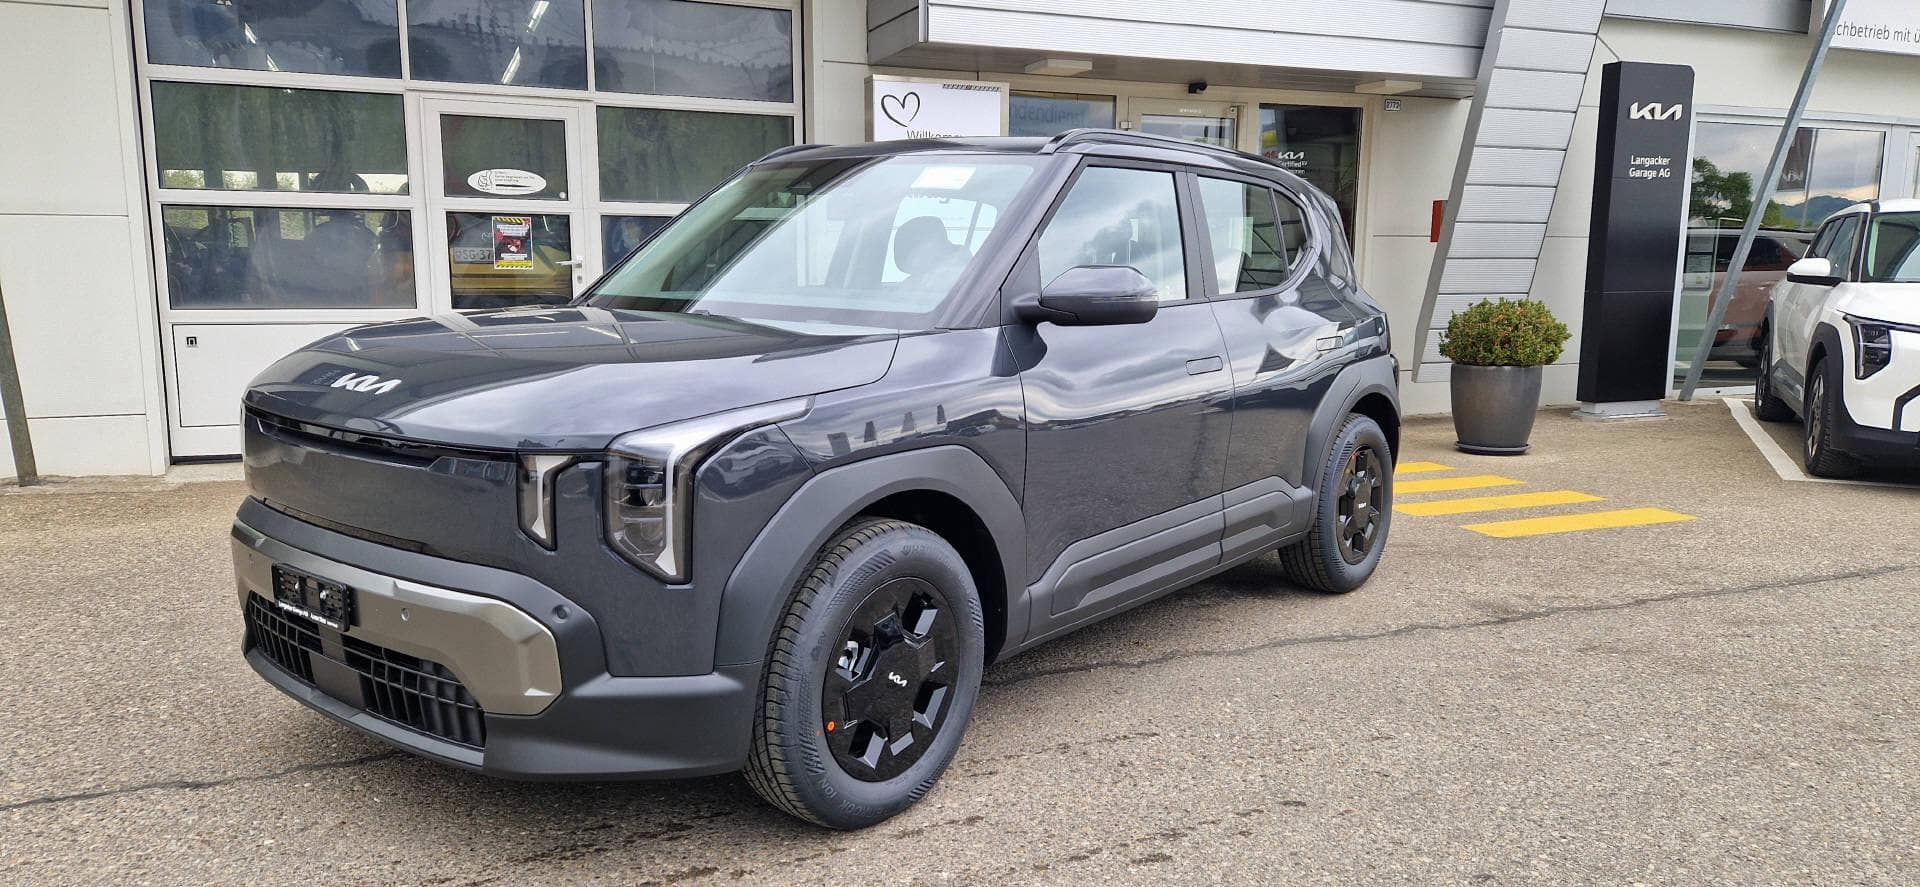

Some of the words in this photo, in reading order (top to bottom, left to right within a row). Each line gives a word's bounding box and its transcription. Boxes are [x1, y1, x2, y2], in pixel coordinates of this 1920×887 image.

[1833, 21, 1890, 40] chbetrieb
[1893, 28, 1911, 42] mit
[1629, 102, 1683, 120] KIA
[1631, 154, 1671, 167] Langacker
[1629, 167, 1657, 179] Garage
[1658, 168, 1671, 178] AG
[330, 372, 402, 395] KIA
